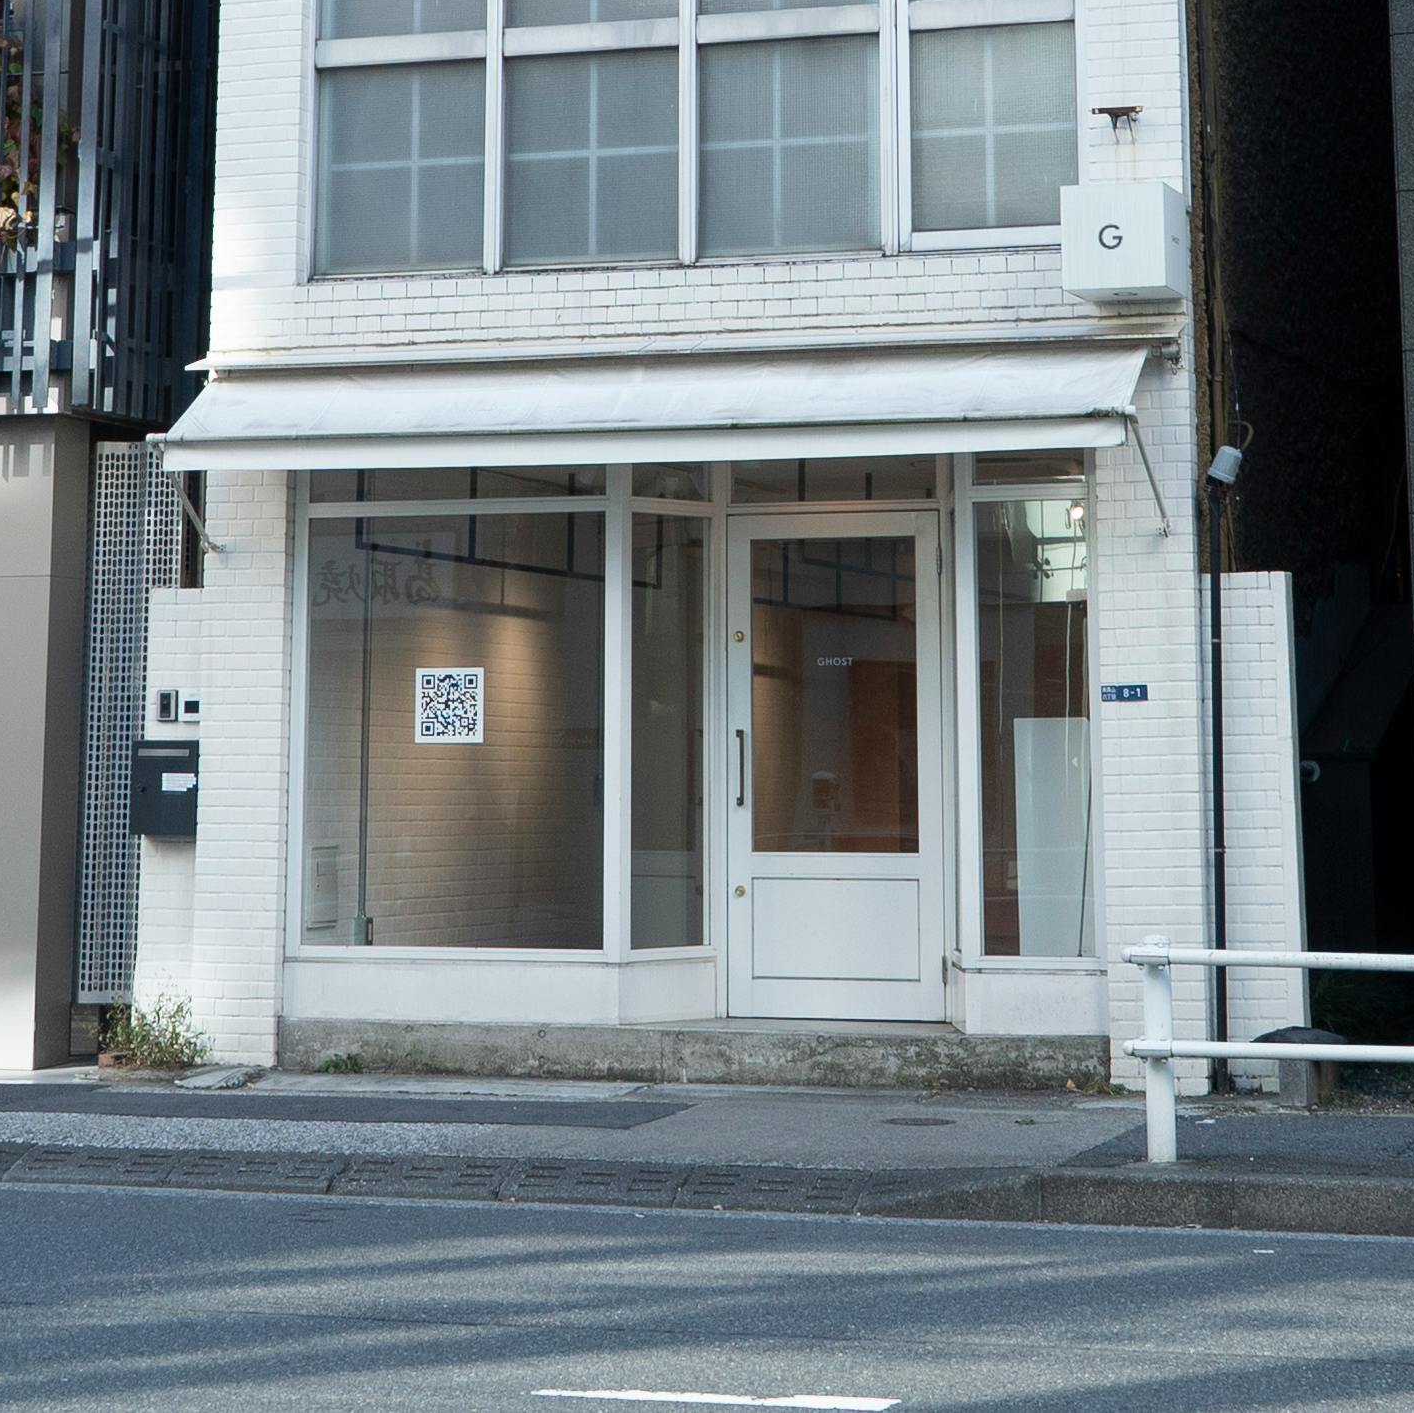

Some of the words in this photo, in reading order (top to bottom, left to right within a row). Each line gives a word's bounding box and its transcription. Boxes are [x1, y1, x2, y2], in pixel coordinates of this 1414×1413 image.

[1098, 224, 1123, 250] G
[817, 657, 853, 667] GHOST
[1122, 687, 1141, 698] 8-1
